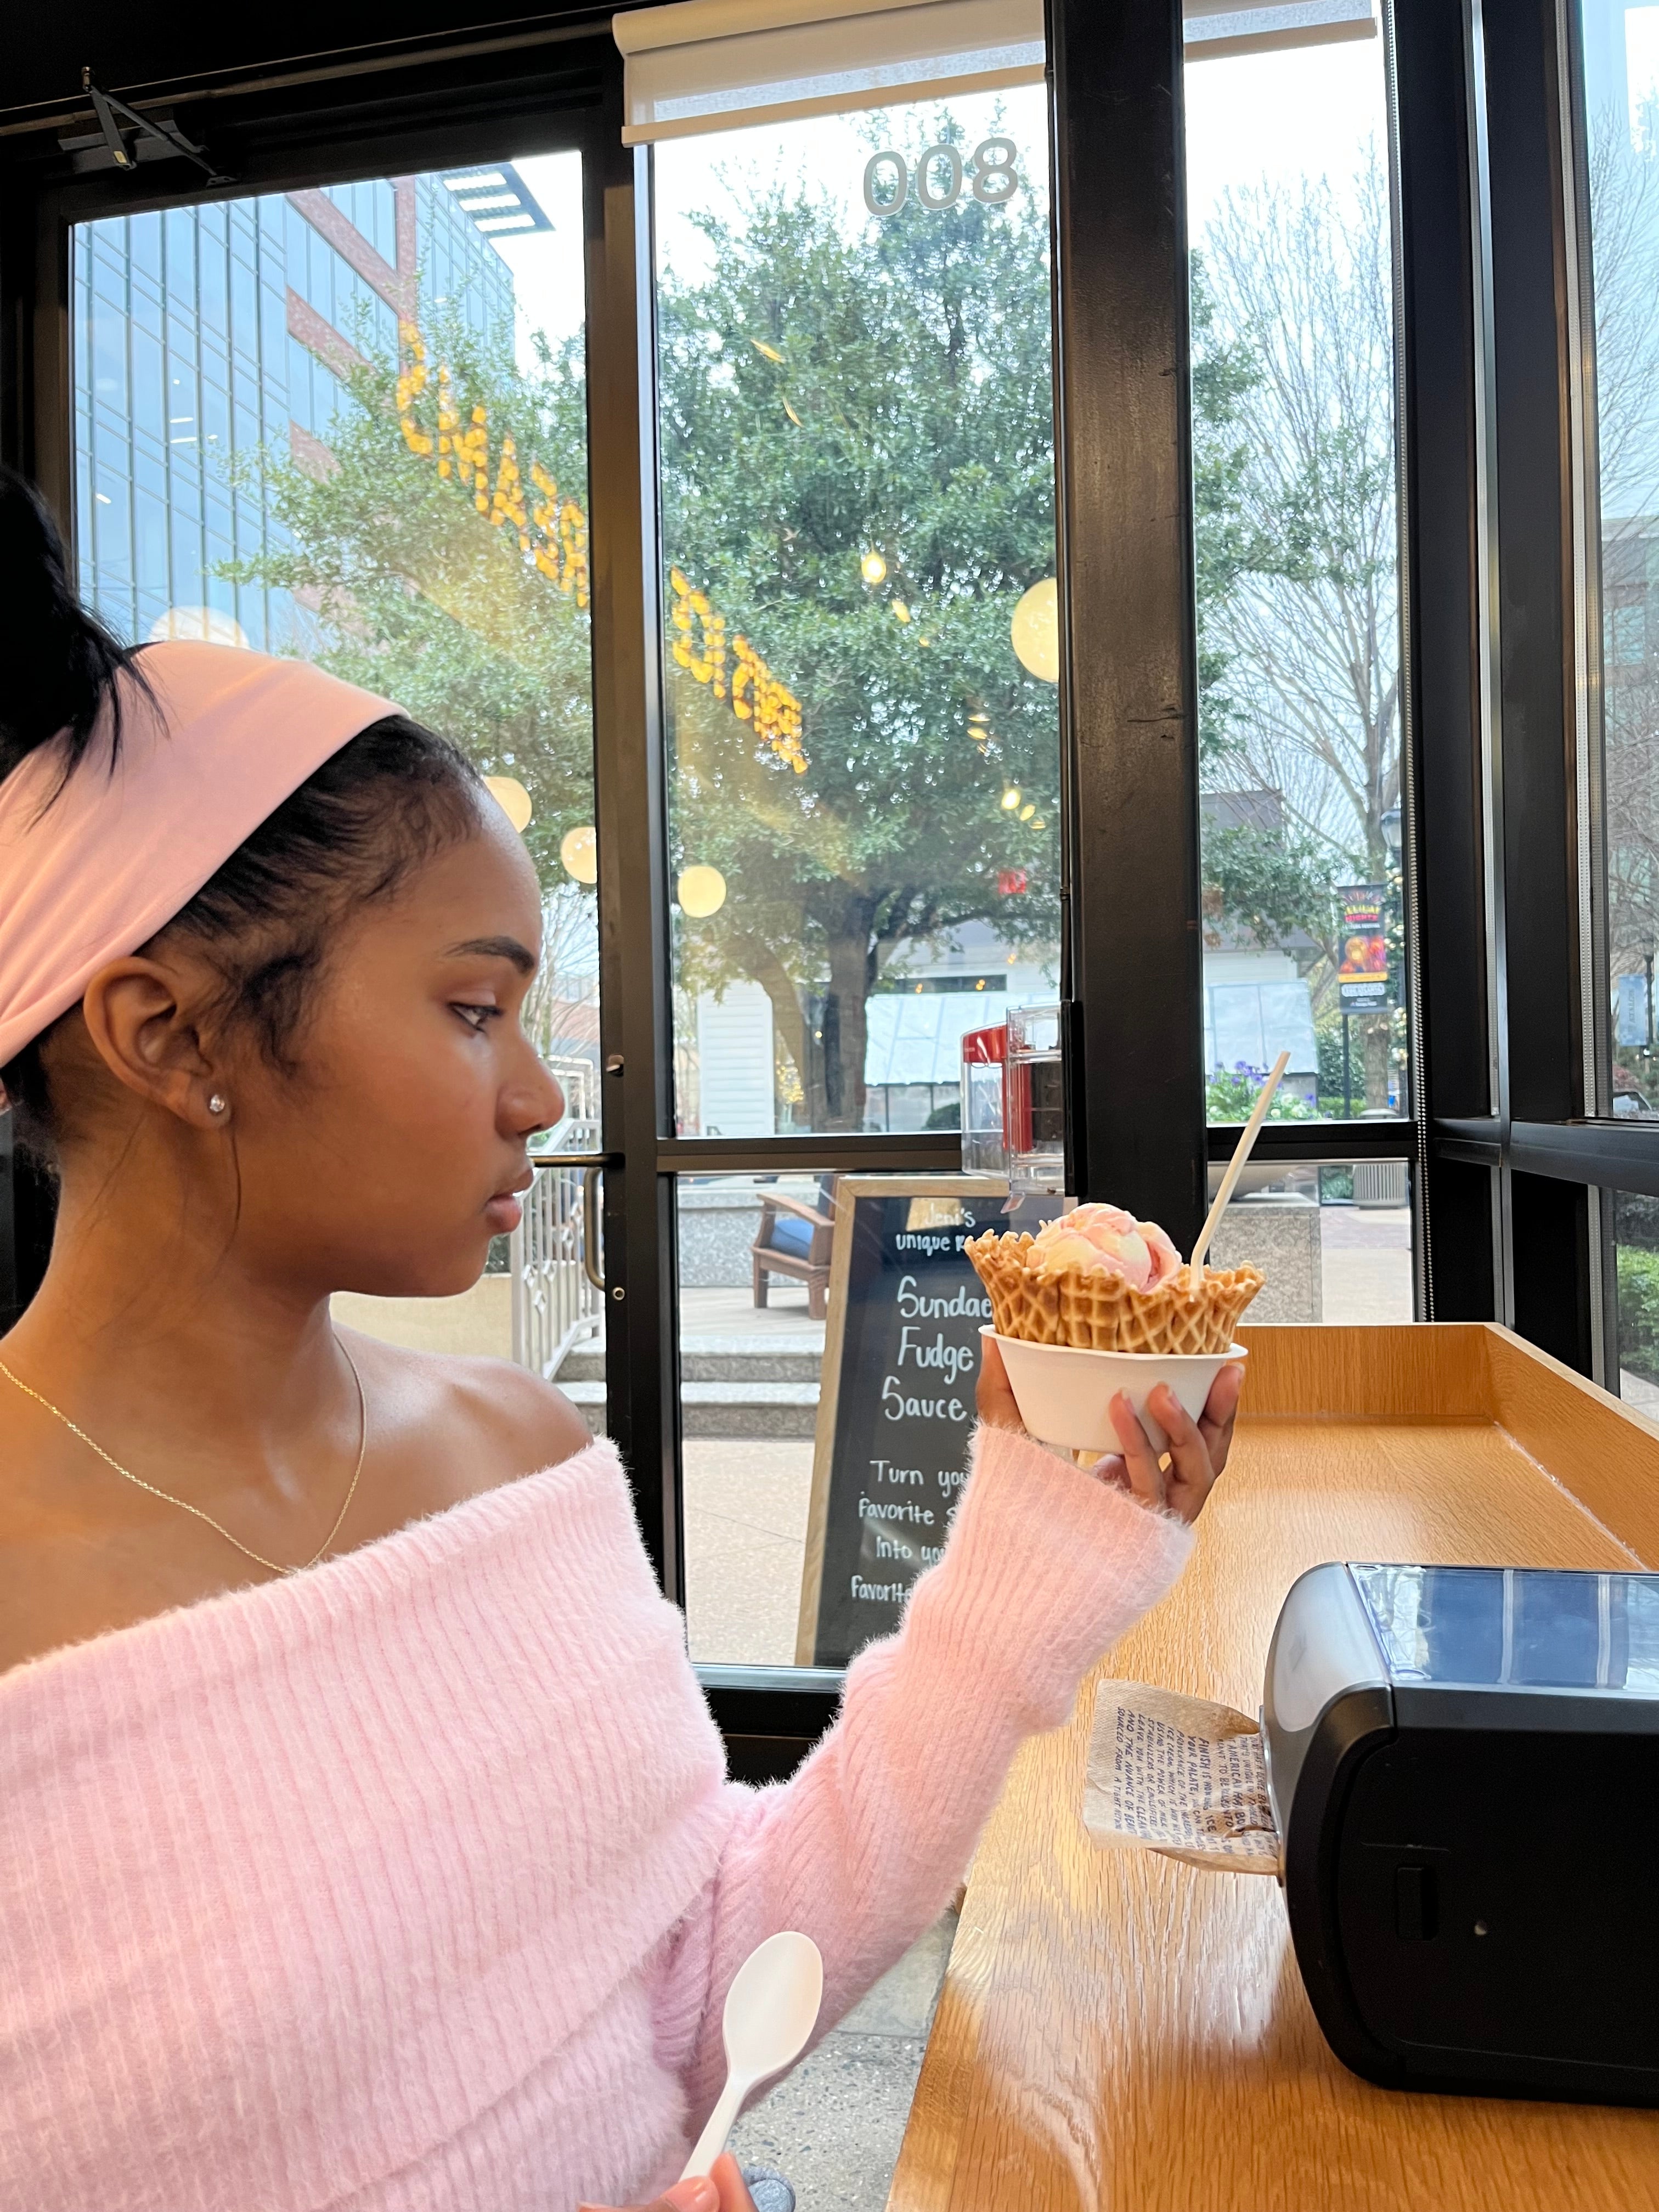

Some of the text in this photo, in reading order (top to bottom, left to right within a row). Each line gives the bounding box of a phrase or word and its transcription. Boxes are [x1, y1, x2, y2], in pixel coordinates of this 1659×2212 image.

[896, 1275, 992, 1318] Sundae
[898, 1326, 974, 1385] Fudge
[881, 1375, 967, 1421] Sauce
[870, 1460, 924, 1485] Turn
[859, 1497, 934, 1525] favorite
[1117, 1707, 1125, 1742] SOURCED
[1127, 1710, 1135, 1732] AND
[1137, 1714, 1146, 1741] LEAVE
[1157, 1722, 1165, 1747] USING
[1188, 1736, 1197, 1757] YOUR
[1177, 1730, 1185, 1777] PROVENANCE
[1125, 1761, 1135, 1797] NUANCE
[1136, 1766, 1144, 1786] WITH
[1147, 1774, 1155, 1784] OR
[1158, 1768, 1166, 1795] POWER
[1187, 1761, 1198, 1795] PALATE,
[1219, 1765, 1228, 1774] TO
[1243, 1760, 1254, 1784] UNIQUE
[1167, 1771, 1176, 1795] WHICH
[1178, 1780, 1185, 1788] OF
[1199, 1737, 1210, 1769] FINISH
[1205, 1815, 1217, 1832] ICE
[1220, 1778, 1230, 1786] BE
[1125, 1801, 1134, 1810] OF
[1136, 1791, 1145, 1803] THE
[1158, 1799, 1166, 1808] OF
[1179, 1793, 1188, 1807] THE
